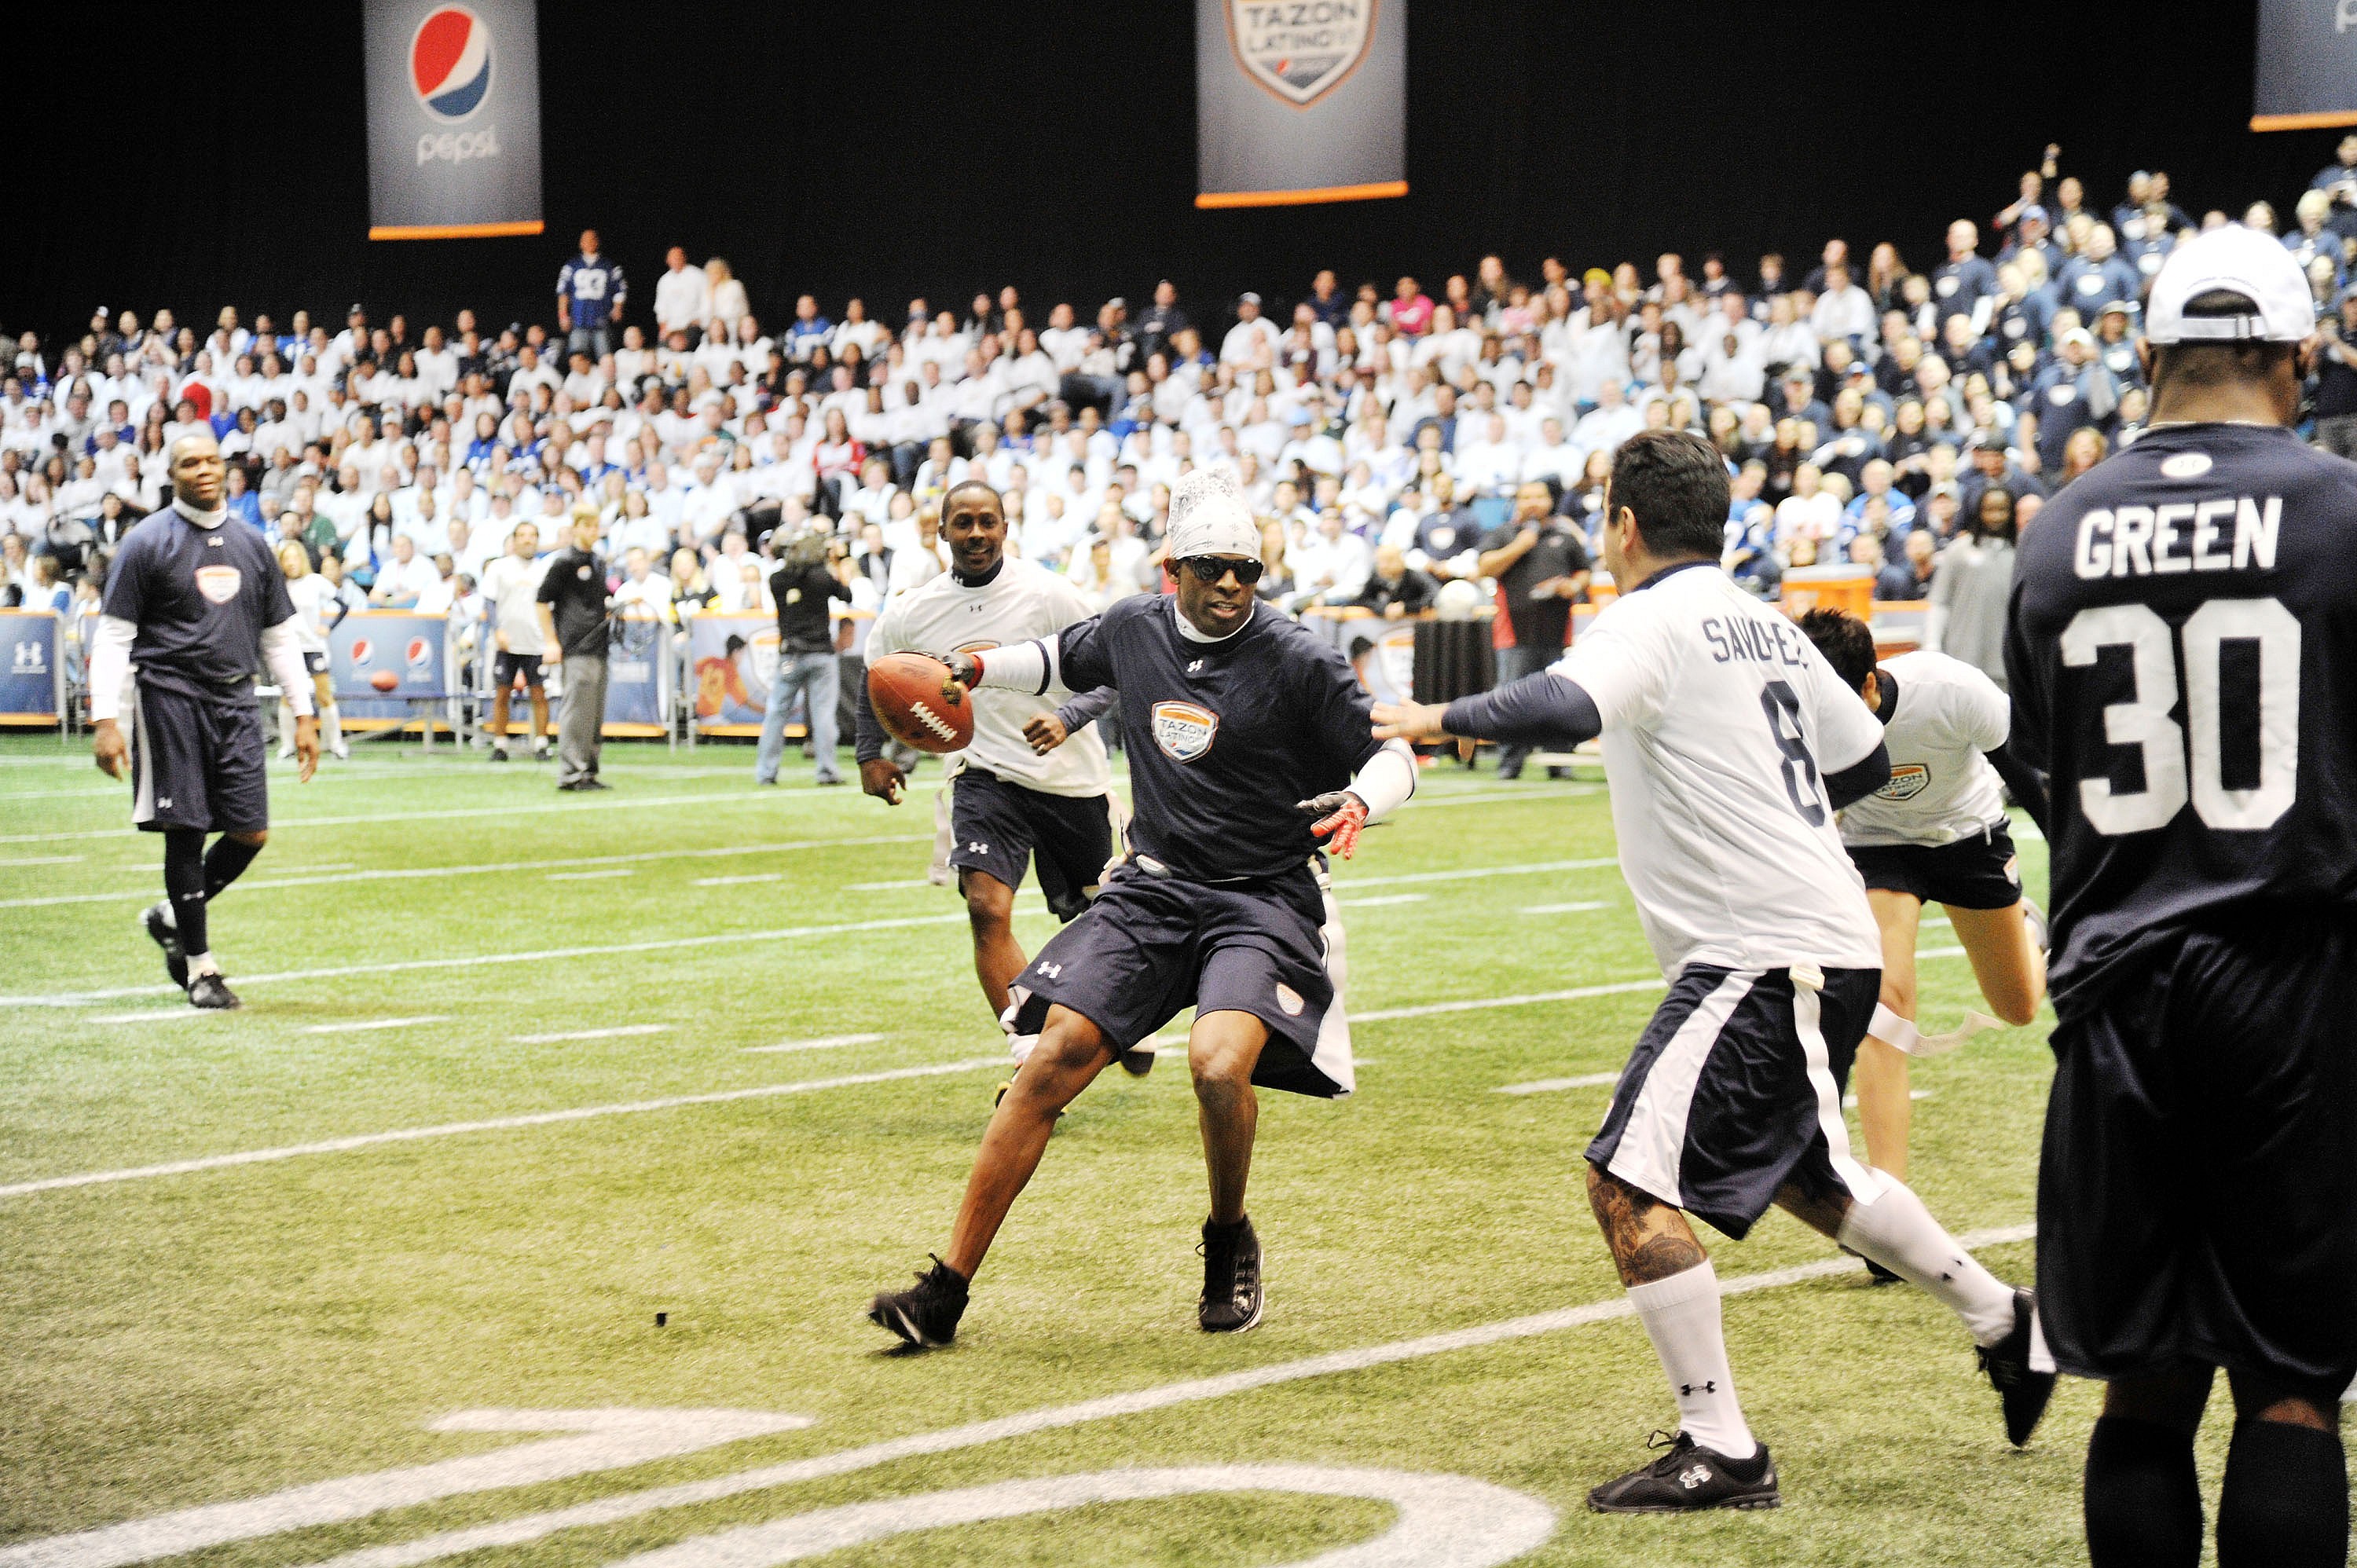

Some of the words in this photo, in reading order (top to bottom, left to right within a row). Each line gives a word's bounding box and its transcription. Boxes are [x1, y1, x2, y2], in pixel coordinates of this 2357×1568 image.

[1246, 2, 1358, 27] TAZON
[416, 124, 502, 167] pepsi
[2074, 496, 2283, 580] GREEN
[1159, 718, 1208, 735] TAZON
[1159, 730, 1196, 744] LATINO
[2059, 596, 2302, 836] 30
[1759, 680, 1826, 829] 8
